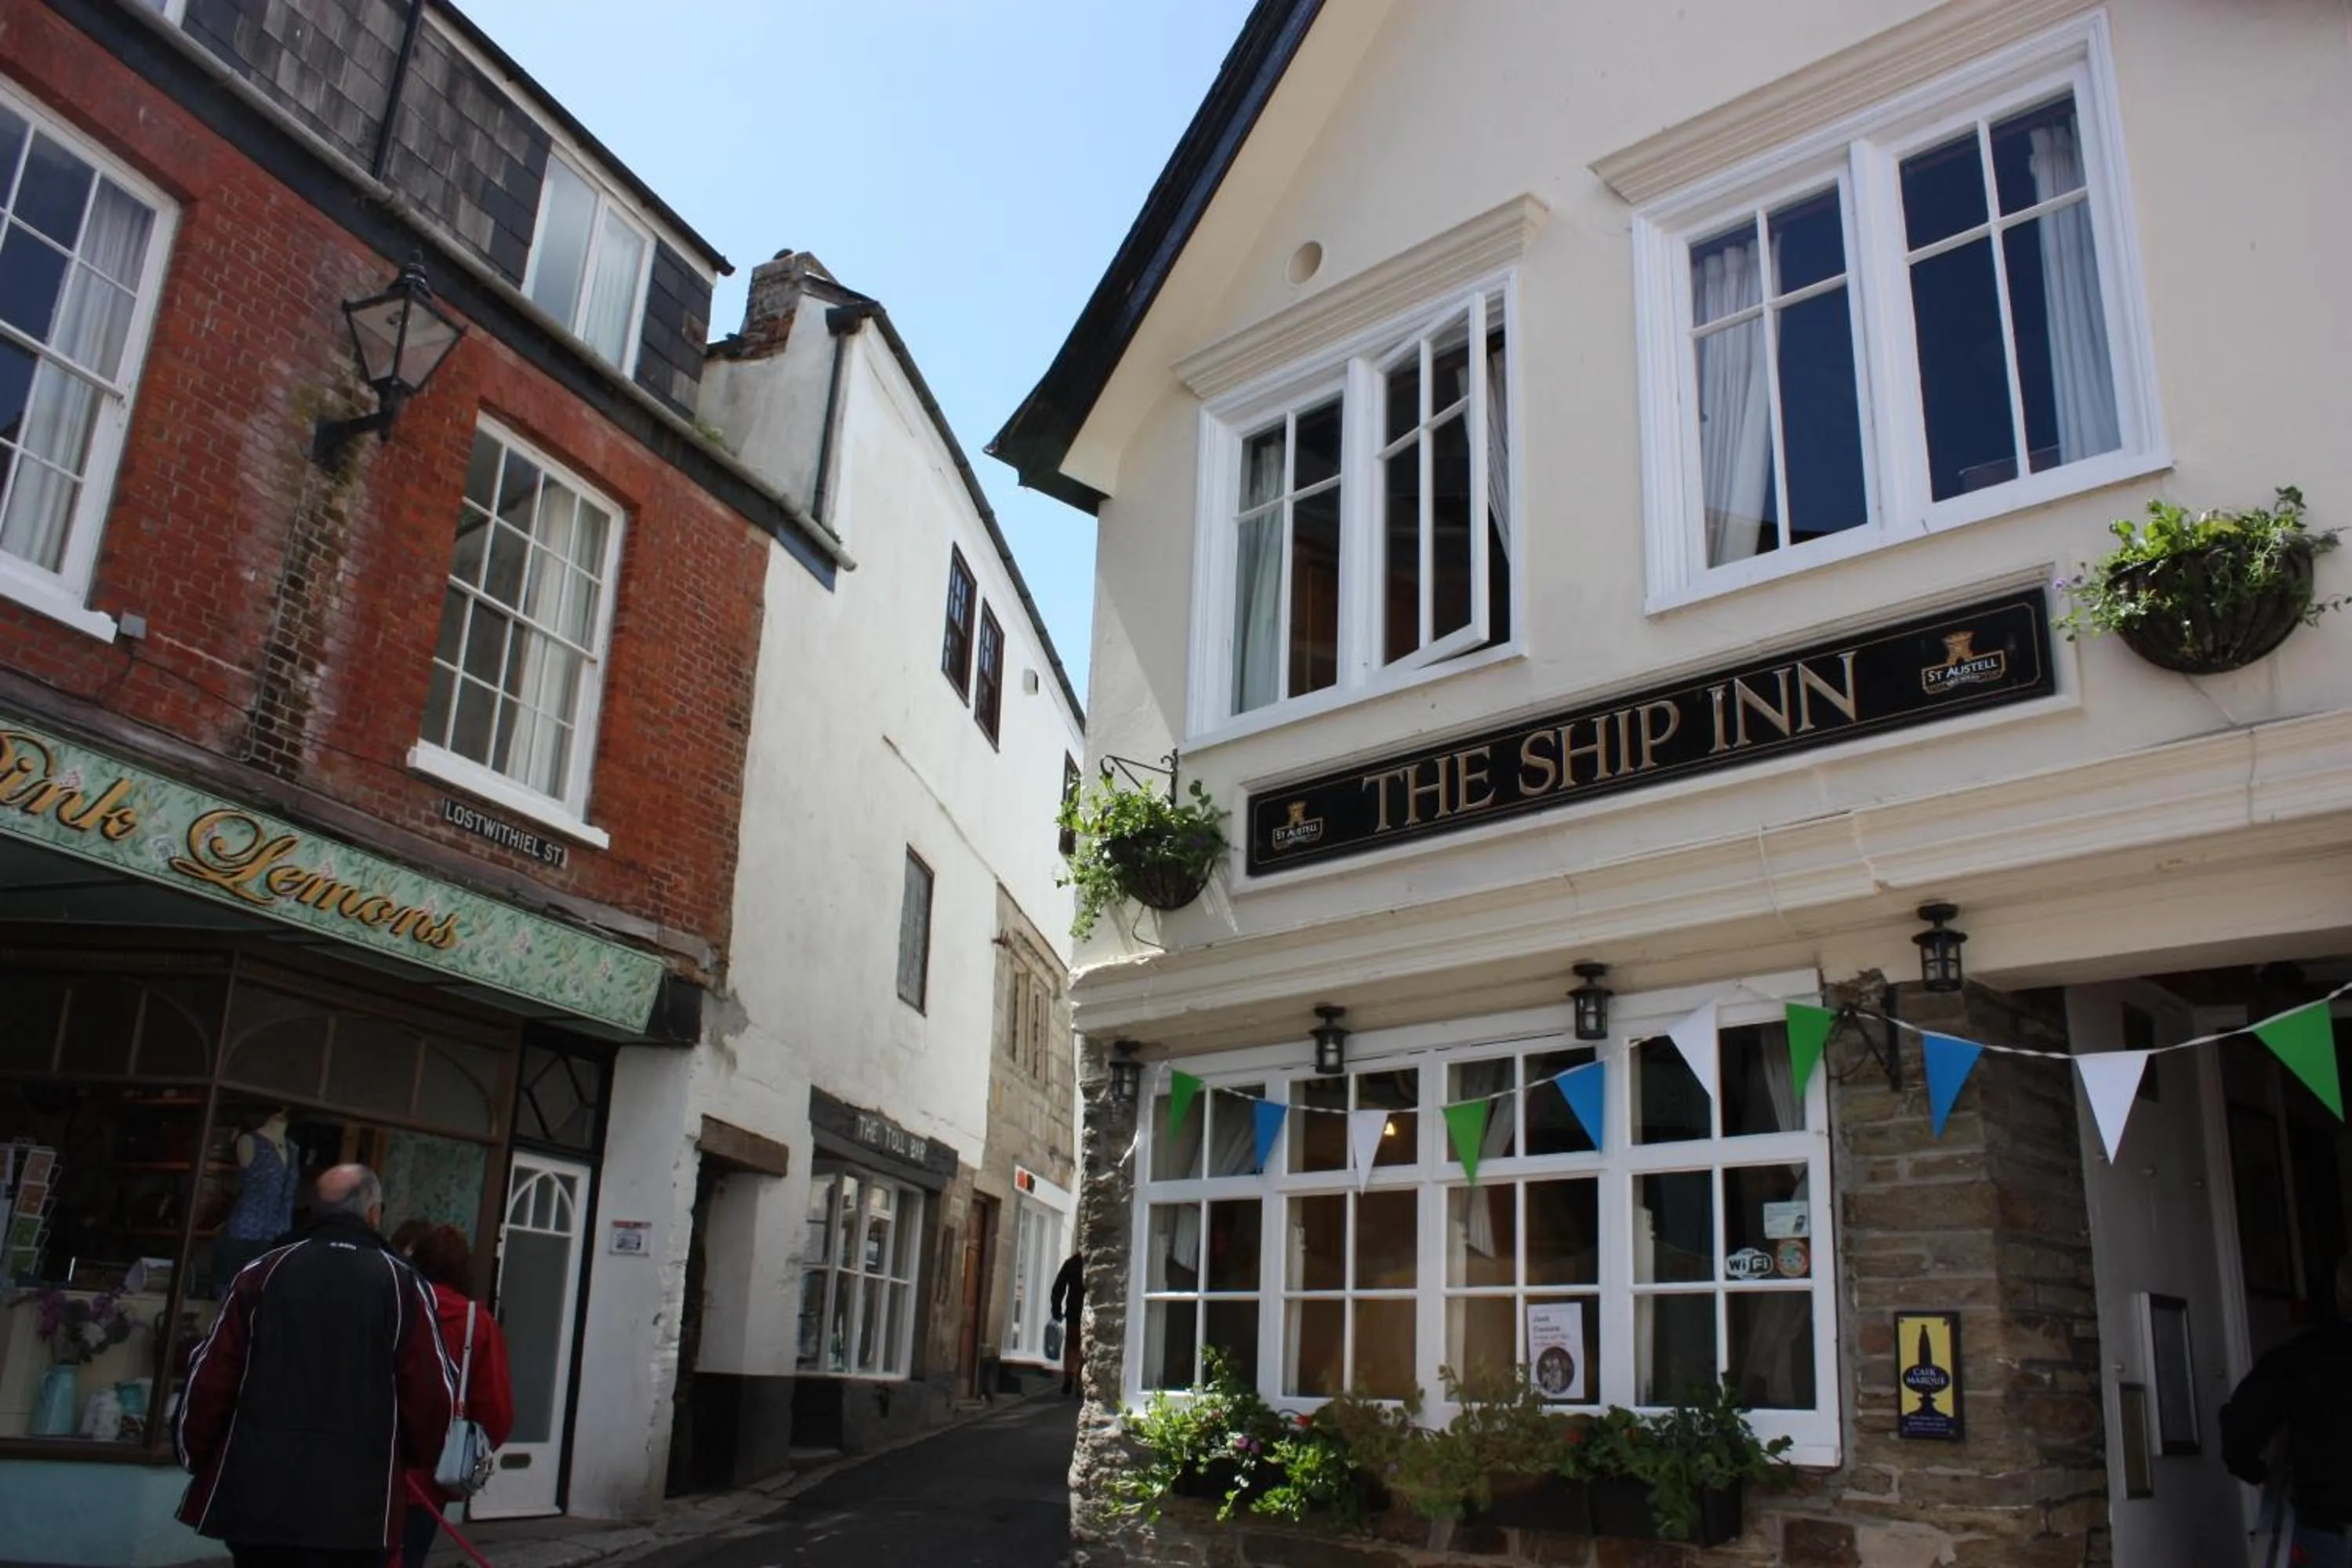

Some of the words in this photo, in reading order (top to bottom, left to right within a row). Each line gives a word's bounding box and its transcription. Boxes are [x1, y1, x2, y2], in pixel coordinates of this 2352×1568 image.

[1928, 670, 1944, 684] ST
[1946, 658, 1997, 678] AUSTELL
[1361, 745, 1496, 833] THE
[1517, 699, 1681, 797] SHIP
[1706, 651, 1857, 754] INN
[444, 800, 541, 858] LOSTWITHIEL
[543, 844, 562, 866] ST
[169, 808, 457, 949] Lemons
[858, 1114, 878, 1143] THE
[884, 1126, 906, 1154] TOLL
[909, 1138, 927, 1161] BAR
